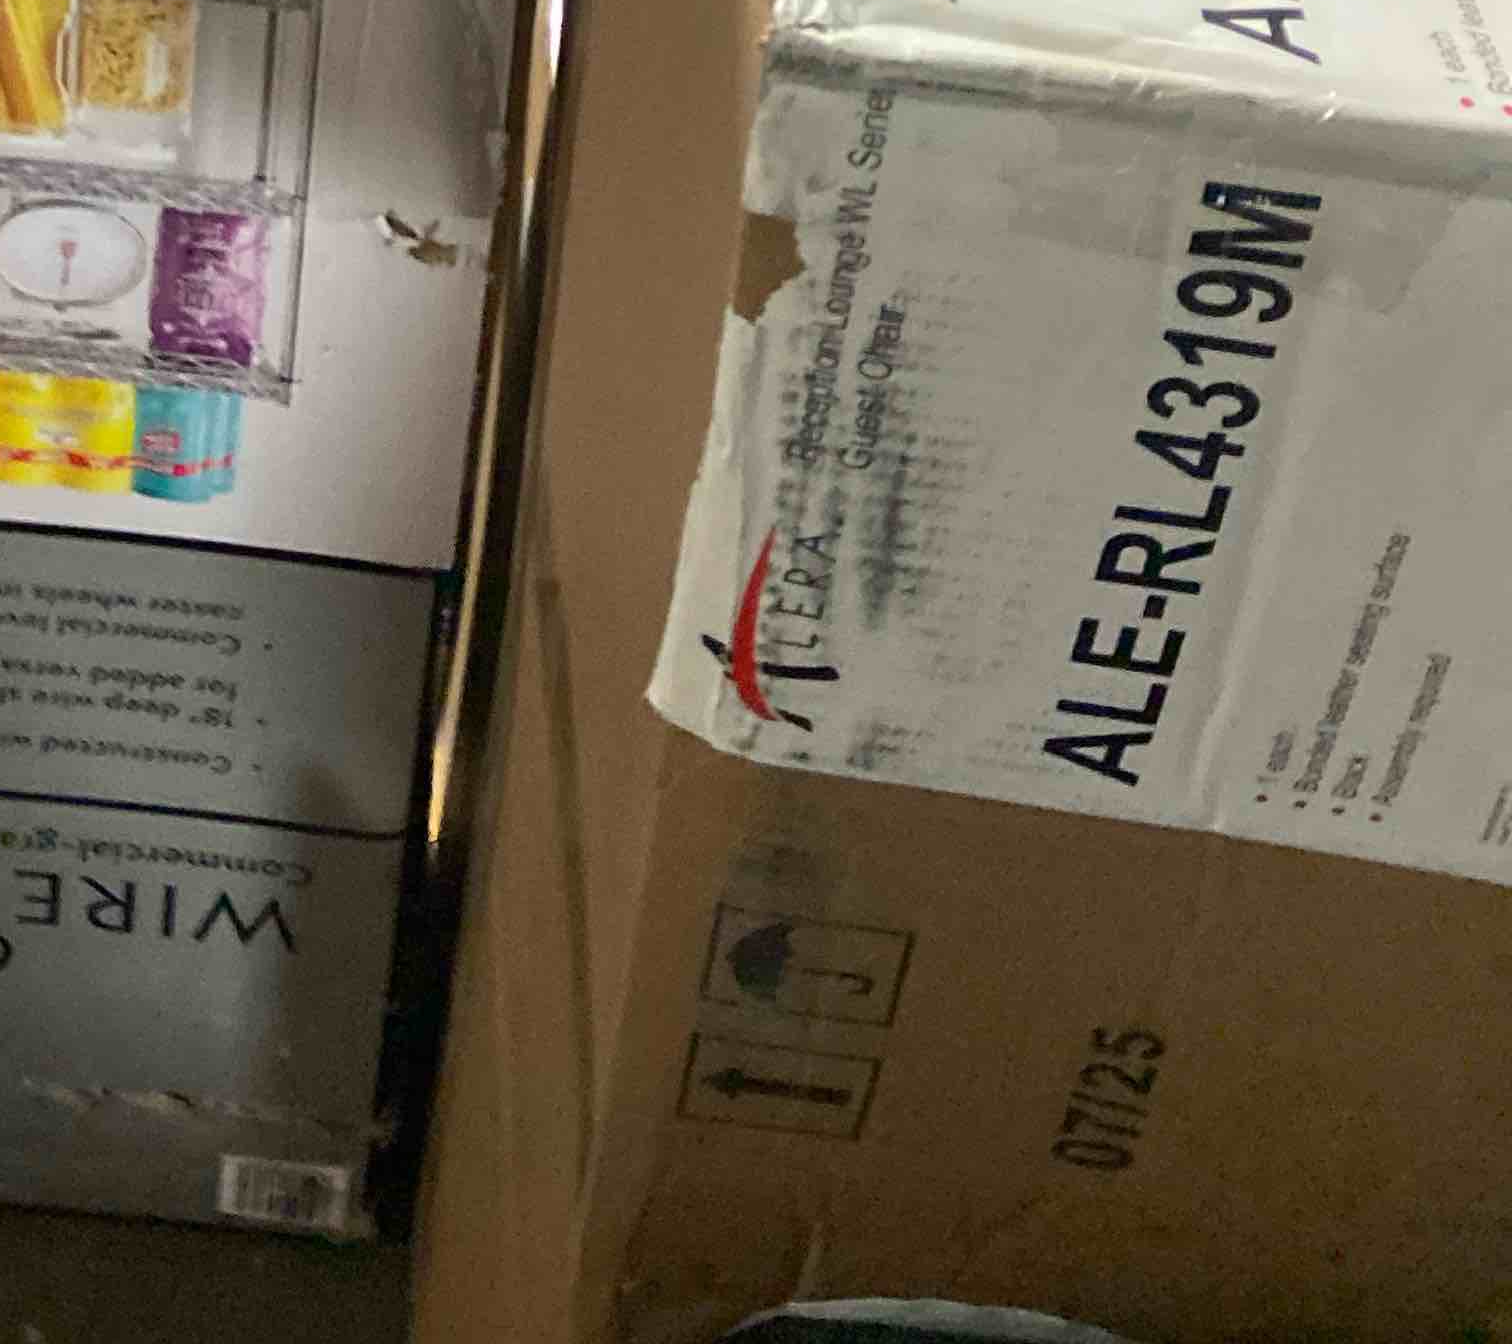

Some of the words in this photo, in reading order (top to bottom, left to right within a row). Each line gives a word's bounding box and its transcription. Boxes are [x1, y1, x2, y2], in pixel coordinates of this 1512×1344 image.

[846, 84, 896, 172] Serie
[838, 181, 878, 225] WL
[810, 232, 872, 330] Lounge
[787, 332, 842, 466] Reception
[838, 384, 889, 471] Guest
[1040, 180, 1323, 788] ALE-RL4319M
[31, 584, 138, 611] wheels
[56, 615, 243, 658] Commercial
[31, 689, 94, 710] wire
[87, 665, 186, 694] added
[194, 677, 238, 703] for
[103, 692, 181, 723] deep
[39, 736, 233, 776] Constructed
[14, 869, 298, 955] WIRE
[1049, 1026, 1167, 1170] 07/25
